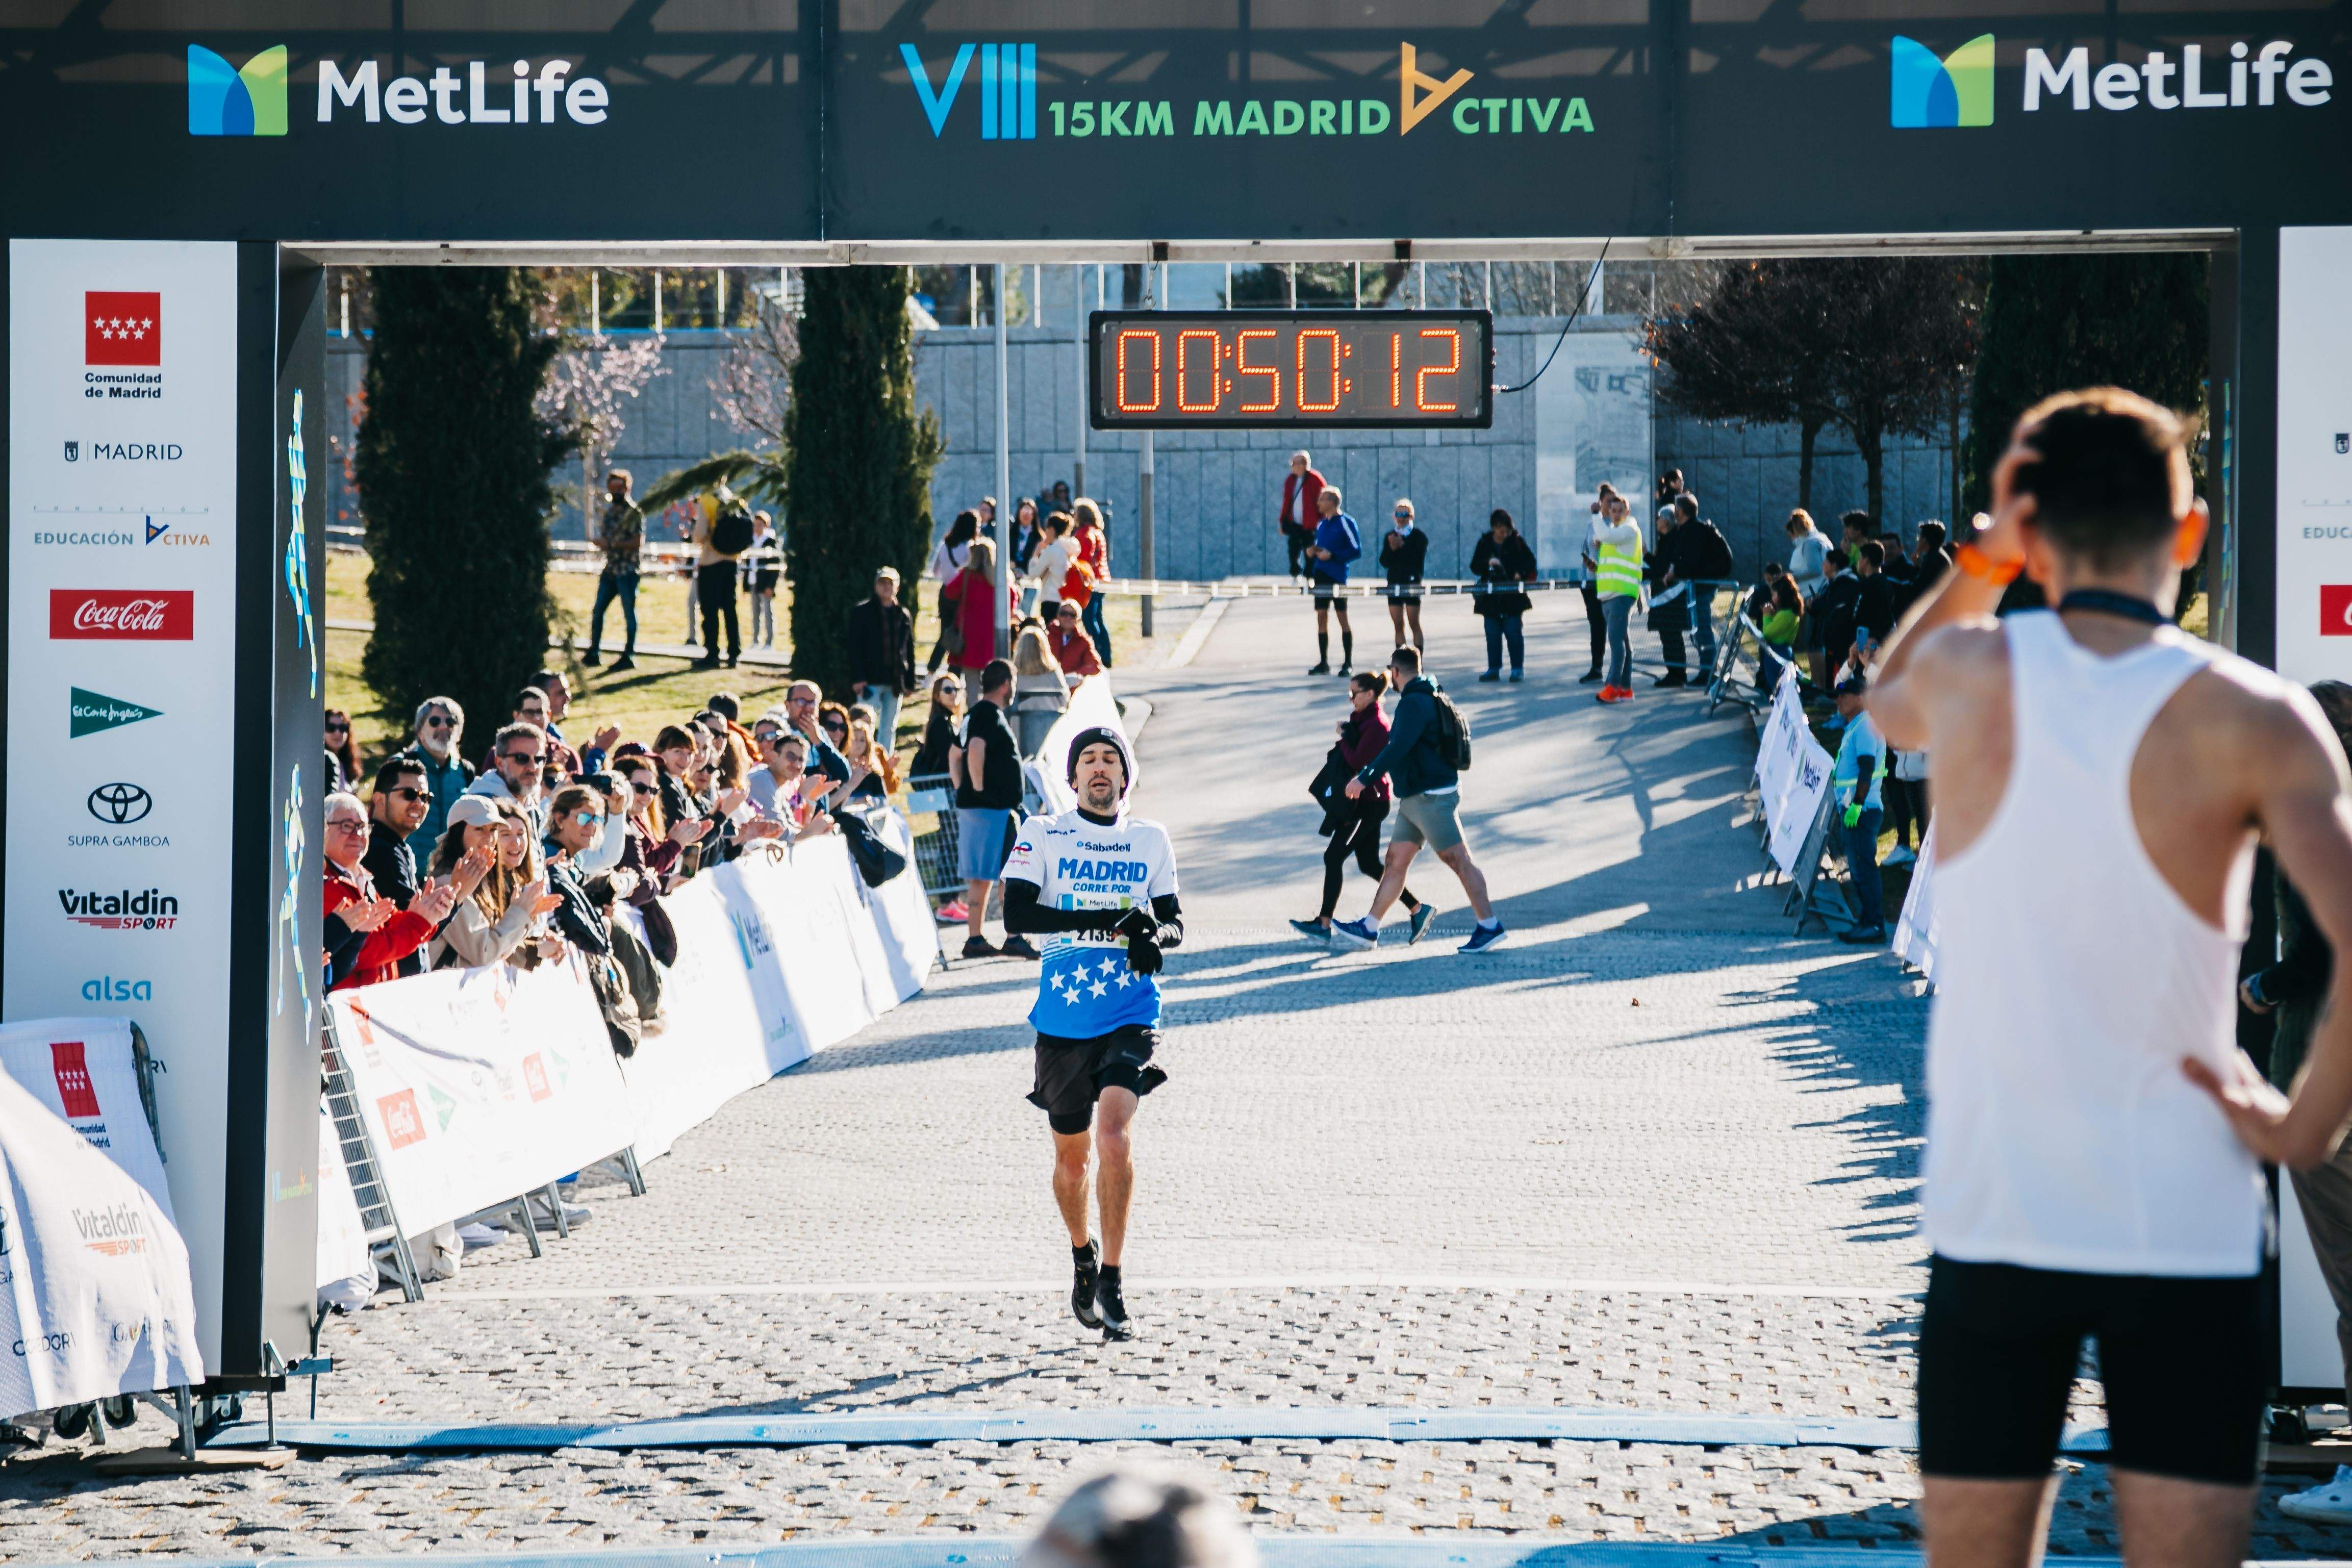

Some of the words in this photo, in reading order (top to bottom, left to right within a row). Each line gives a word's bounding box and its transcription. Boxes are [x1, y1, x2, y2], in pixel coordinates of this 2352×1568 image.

[2024, 41, 2333, 111] MetLife
[318, 60, 609, 124] MetLife
[899, 43, 1036, 139] VIII
[1049, 101, 1174, 137] 15KM
[1194, 99, 1390, 136] MADRID
[85, 373, 162, 384] Comunidad
[1118, 330, 1460, 412] 00:50:12
[85, 387, 103, 398] de
[109, 387, 161, 398] Madrid
[95, 443, 182, 460] MADRID
[34, 530, 133, 545] EDUCACIÓN
[74, 599, 169, 630] Coca-Cola
[68, 836, 109, 847] SUPRA
[113, 836, 169, 847] GAMBOA
[1084, 842, 1131, 852] Sabadell
[1057, 857, 1148, 882] MADRID
[1073, 883, 1107, 893] CORRE
[1111, 885, 1131, 894] POR
[59, 888, 178, 915] Vitaldin
[1090, 899, 1118, 907] MetLife
[82, 975, 151, 1001] alsa
[71, 1202, 144, 1240] Vitaldin
